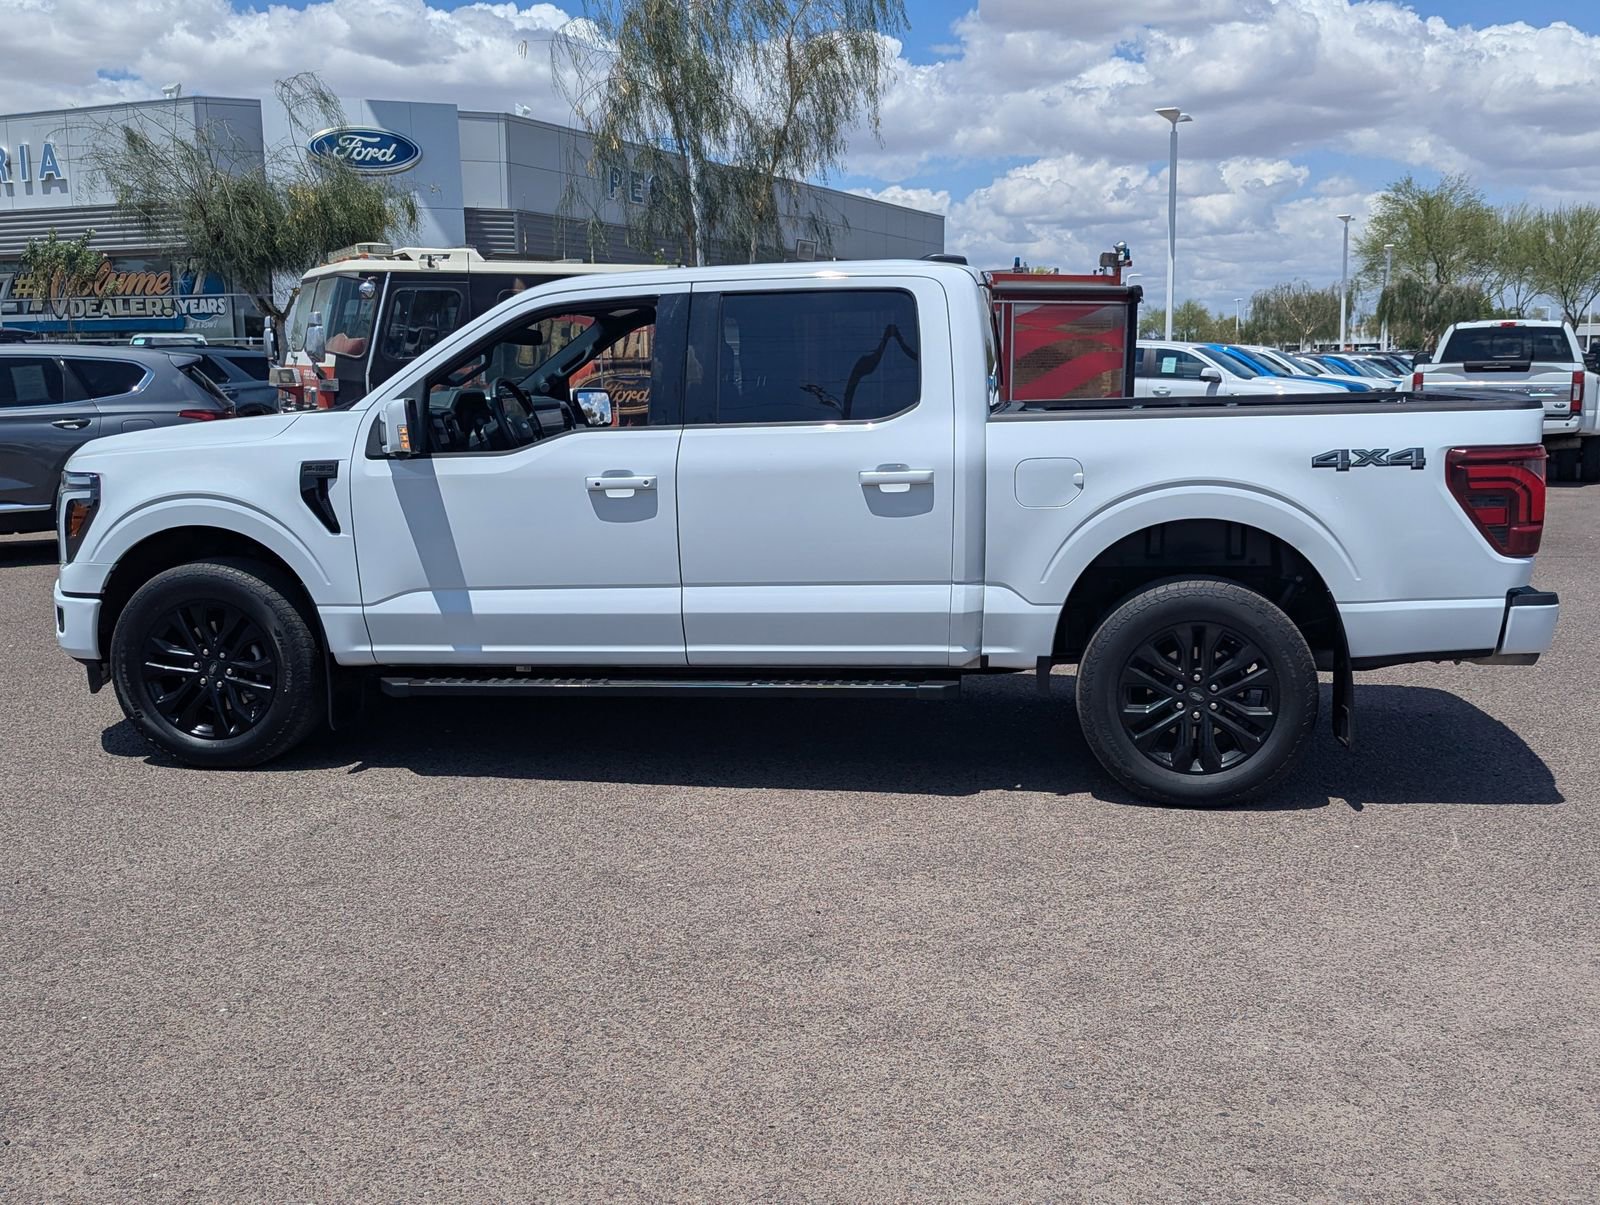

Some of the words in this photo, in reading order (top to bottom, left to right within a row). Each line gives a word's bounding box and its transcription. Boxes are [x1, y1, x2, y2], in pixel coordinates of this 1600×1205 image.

[333, 135, 397, 162] Ford
[69, 298, 174, 317] DEALER!
[178, 298, 227, 315] YEARS
[604, 380, 650, 403] Ford
